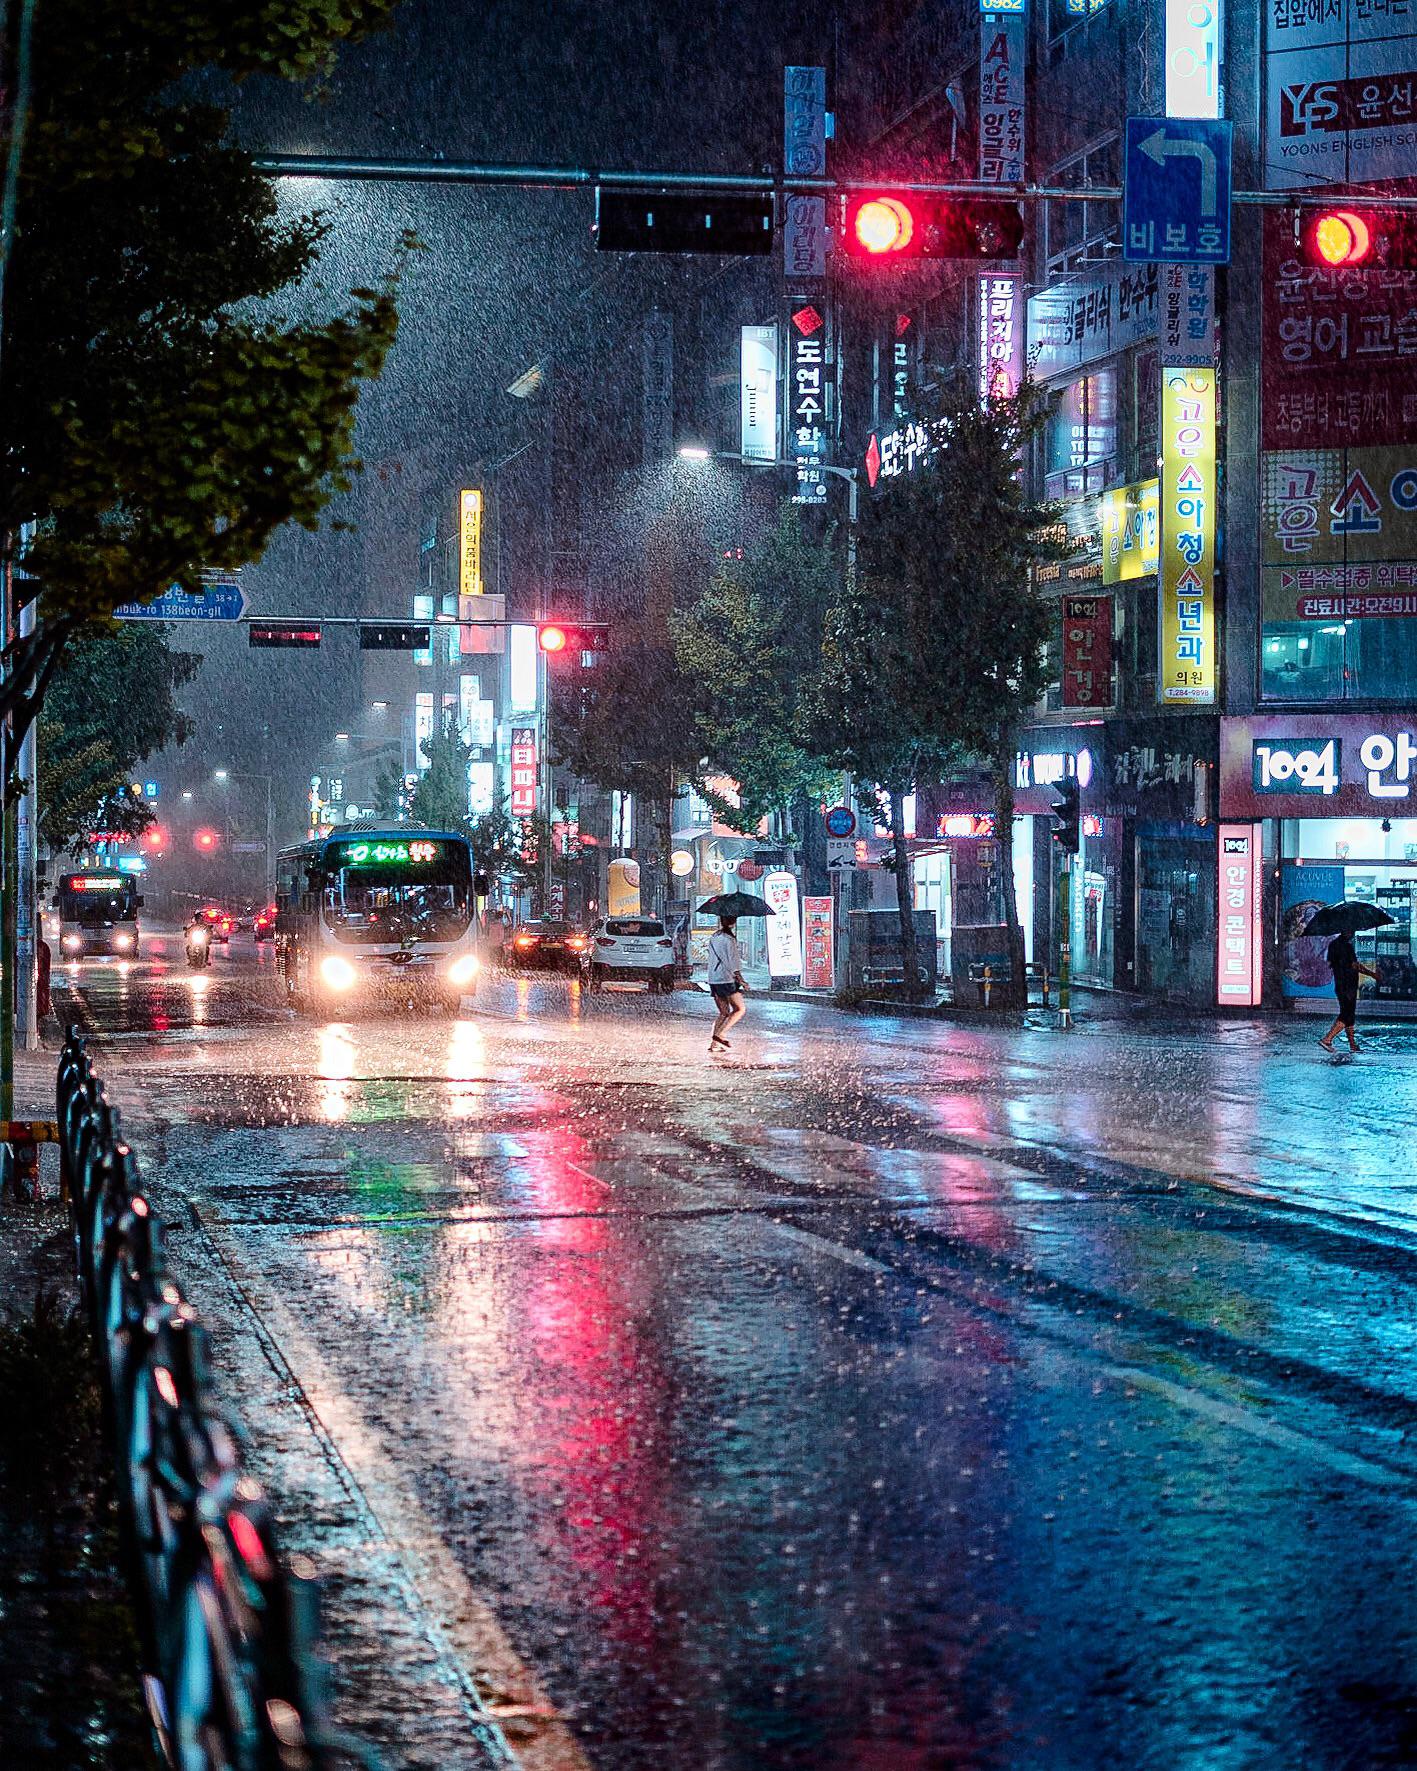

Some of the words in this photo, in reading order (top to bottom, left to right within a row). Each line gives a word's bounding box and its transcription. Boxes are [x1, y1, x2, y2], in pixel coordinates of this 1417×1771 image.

[1357, 83, 1417, 119] 윤선
[1280, 142, 1328, 157] YOONS
[1332, 136, 1392, 153] ENGLISH
[1397, 132, 1417, 146] SC
[1131, 220, 1223, 254] 비보호
[1279, 312, 1348, 362] 영어
[796, 340, 821, 453] 도연수학
[1275, 464, 1320, 552] 고은
[1297, 566, 1372, 590] 필수접종
[1377, 564, 1417, 588] 위탁
[161, 604, 221, 618] 138beon-gil
[1069, 629, 1095, 702] 안경
[1175, 671, 1203, 685] 의원
[1256, 739, 1339, 795] 1004
[1225, 838, 1248, 854] 1004
[1226, 866, 1247, 908] 안경
